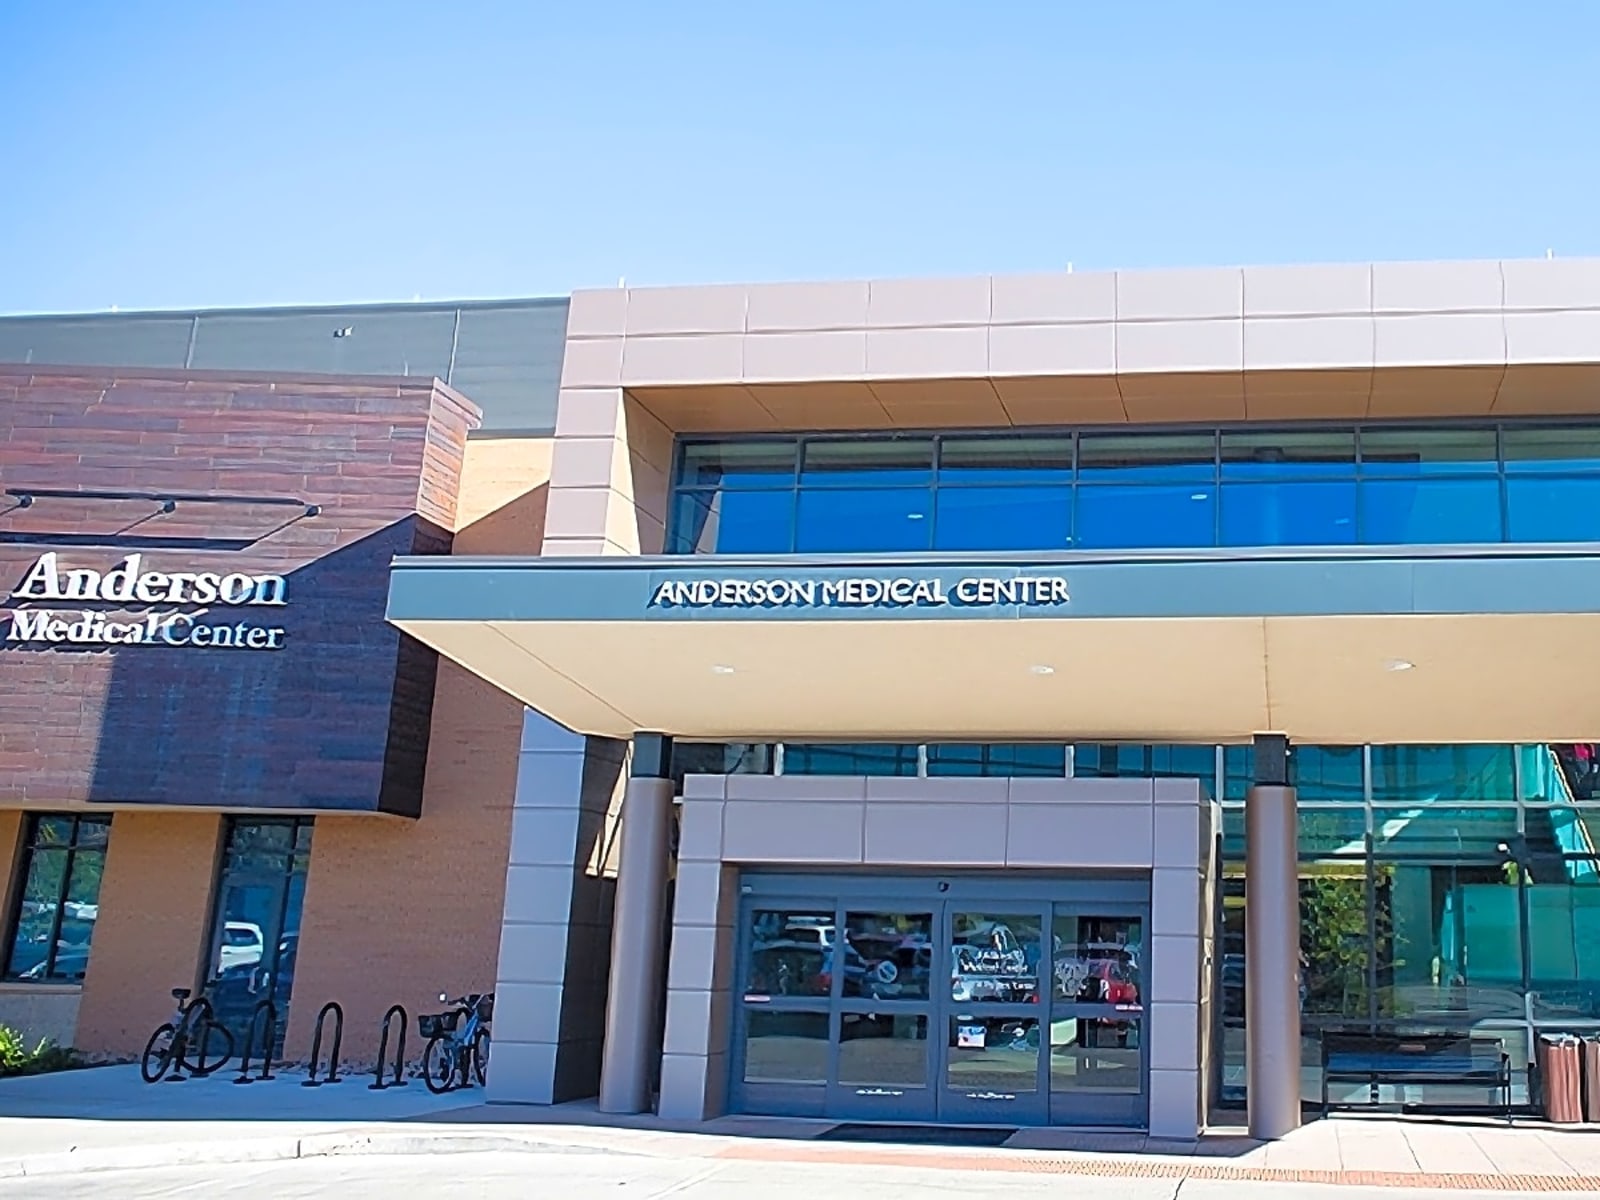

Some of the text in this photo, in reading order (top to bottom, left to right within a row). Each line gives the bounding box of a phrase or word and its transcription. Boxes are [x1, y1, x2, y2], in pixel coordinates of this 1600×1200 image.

[11, 551, 288, 606] Anderson
[654, 576, 1069, 604] ANDERSON MEDICAL CENTER
[6, 609, 285, 649] Medical Center
